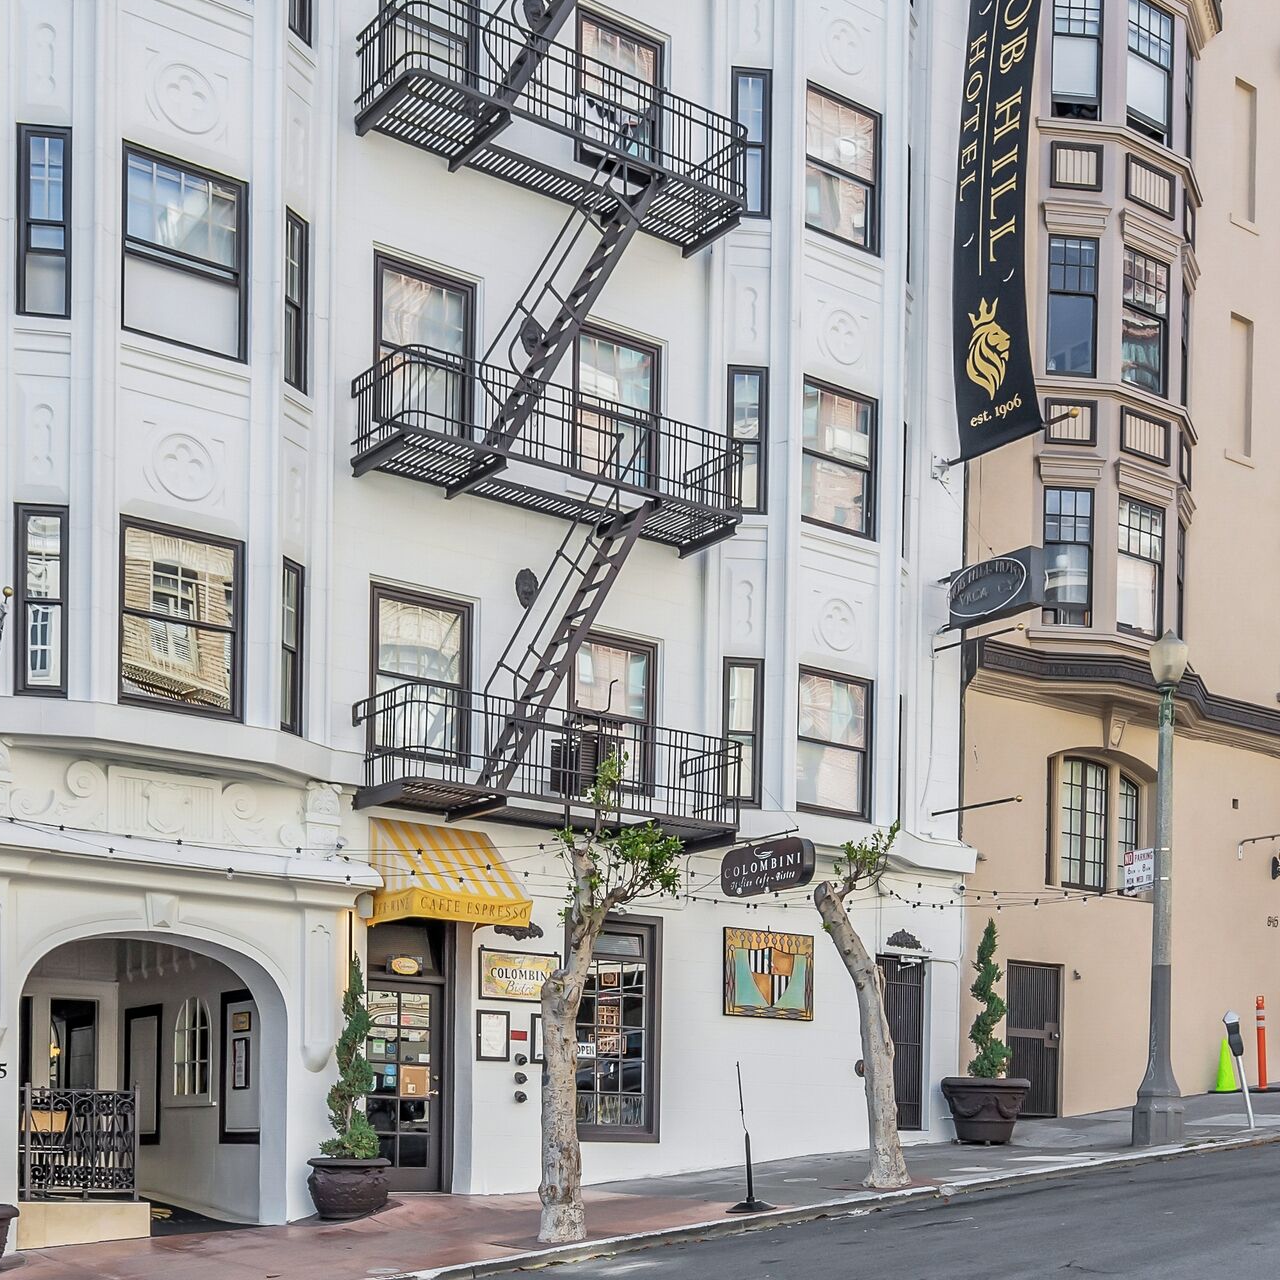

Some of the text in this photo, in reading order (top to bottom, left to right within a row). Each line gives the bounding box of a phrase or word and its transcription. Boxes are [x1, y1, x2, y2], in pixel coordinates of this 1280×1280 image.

[958, 30, 988, 203] HOTEL
[989, 86, 1023, 263] HILL
[970, 393, 1022, 427] est. 1906
[724, 852, 800, 879] COLOMBINI
[1125, 852, 1133, 865] NO
[467, 899, 529, 919] ESPRESSO
